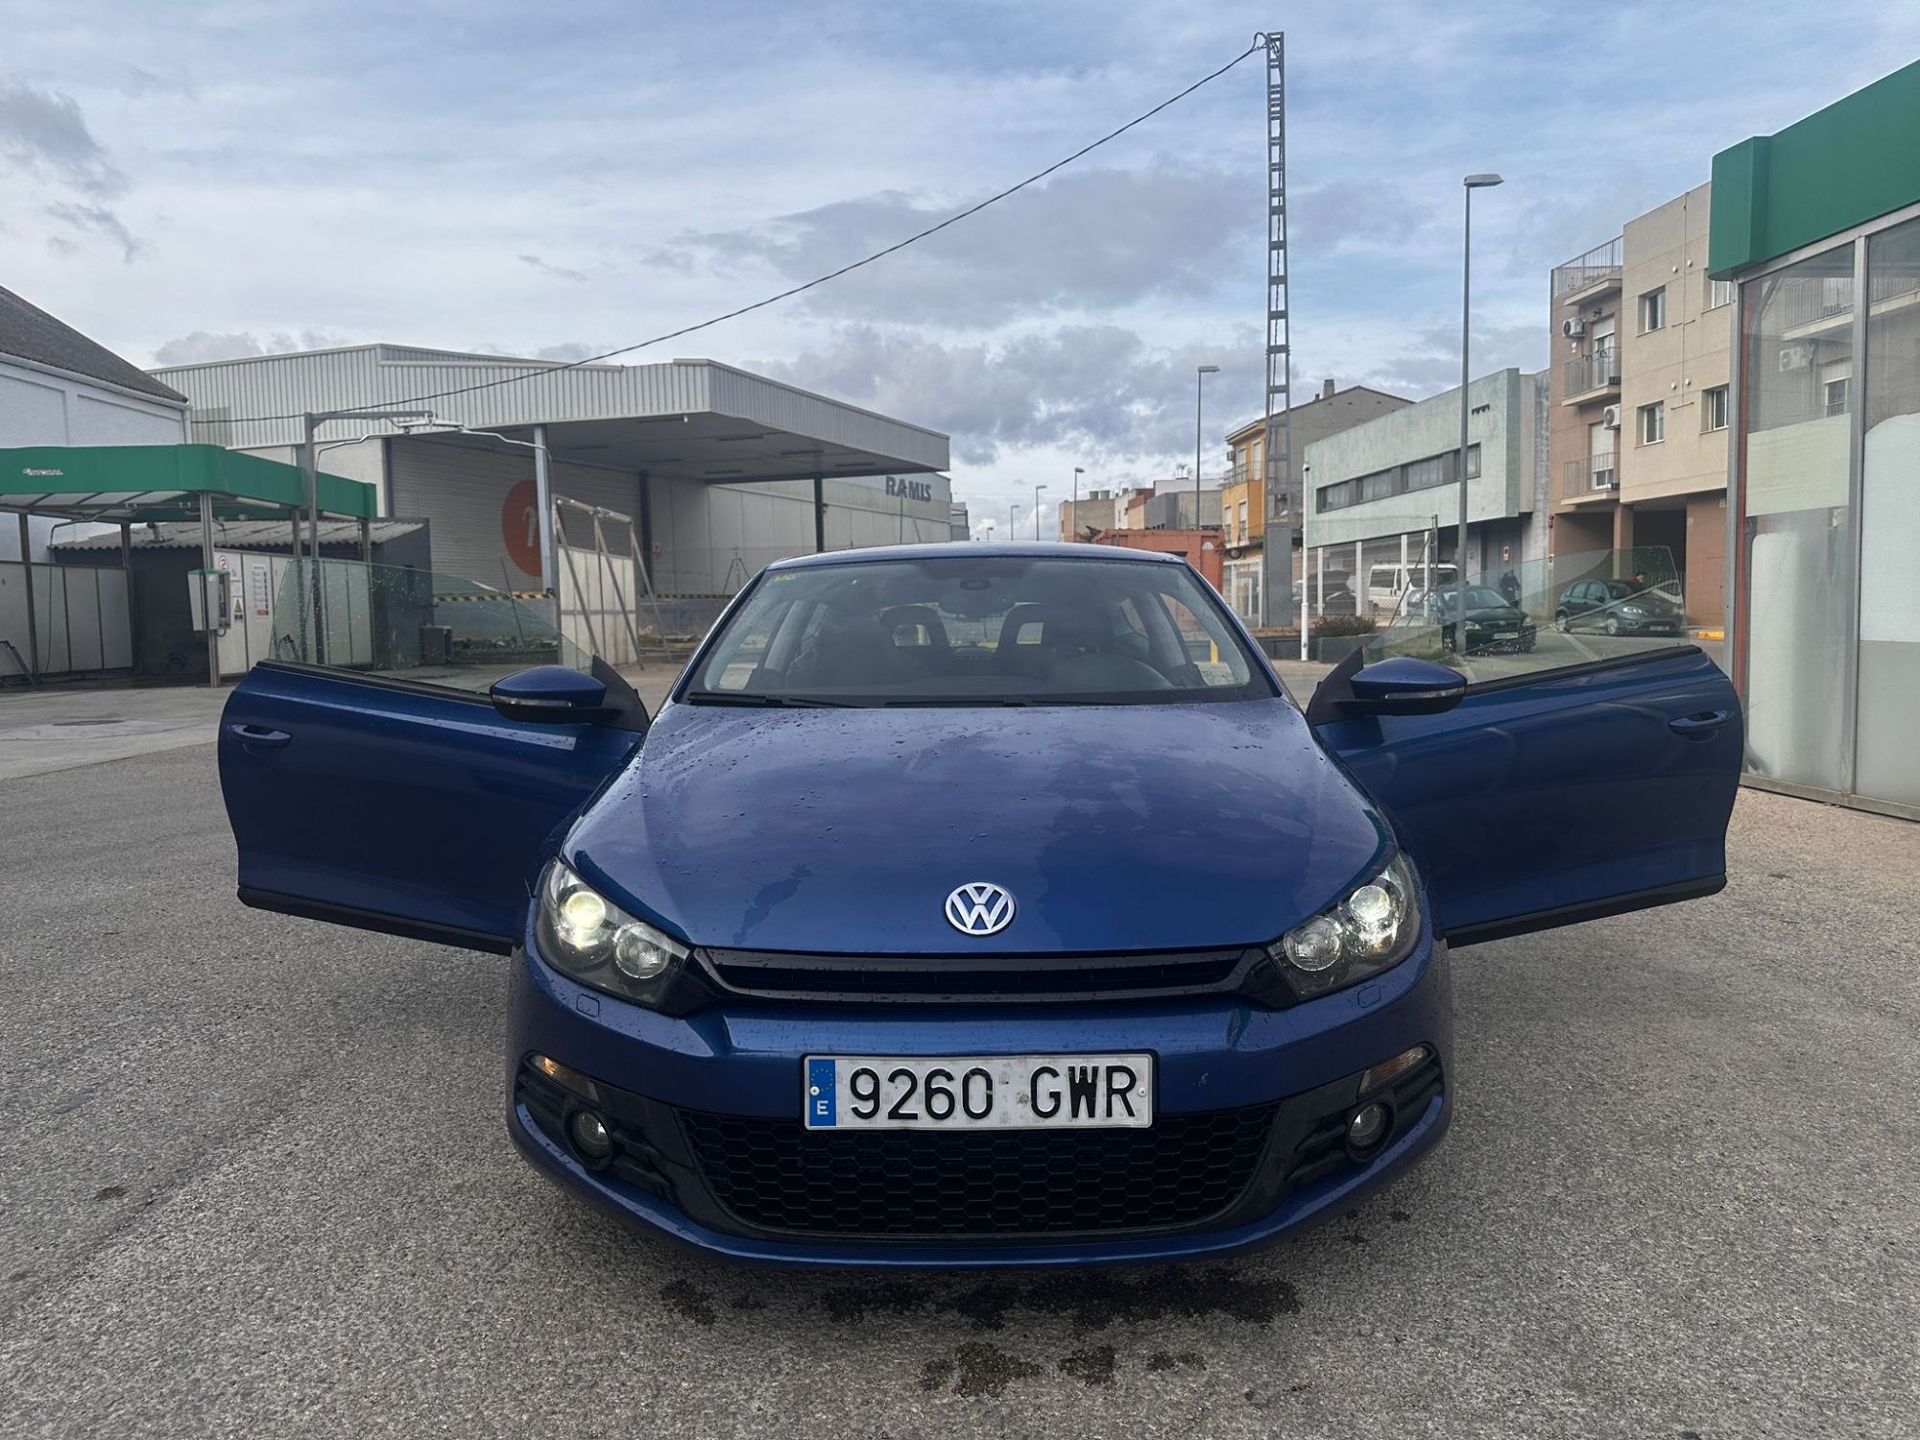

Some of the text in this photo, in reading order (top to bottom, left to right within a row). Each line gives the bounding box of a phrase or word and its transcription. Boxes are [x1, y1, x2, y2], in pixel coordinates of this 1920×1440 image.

[886, 476, 931, 502] RAMIS
[945, 882, 1015, 935] VW
[817, 1100, 829, 1115] E
[850, 1065, 1138, 1120] 9260 GWR
